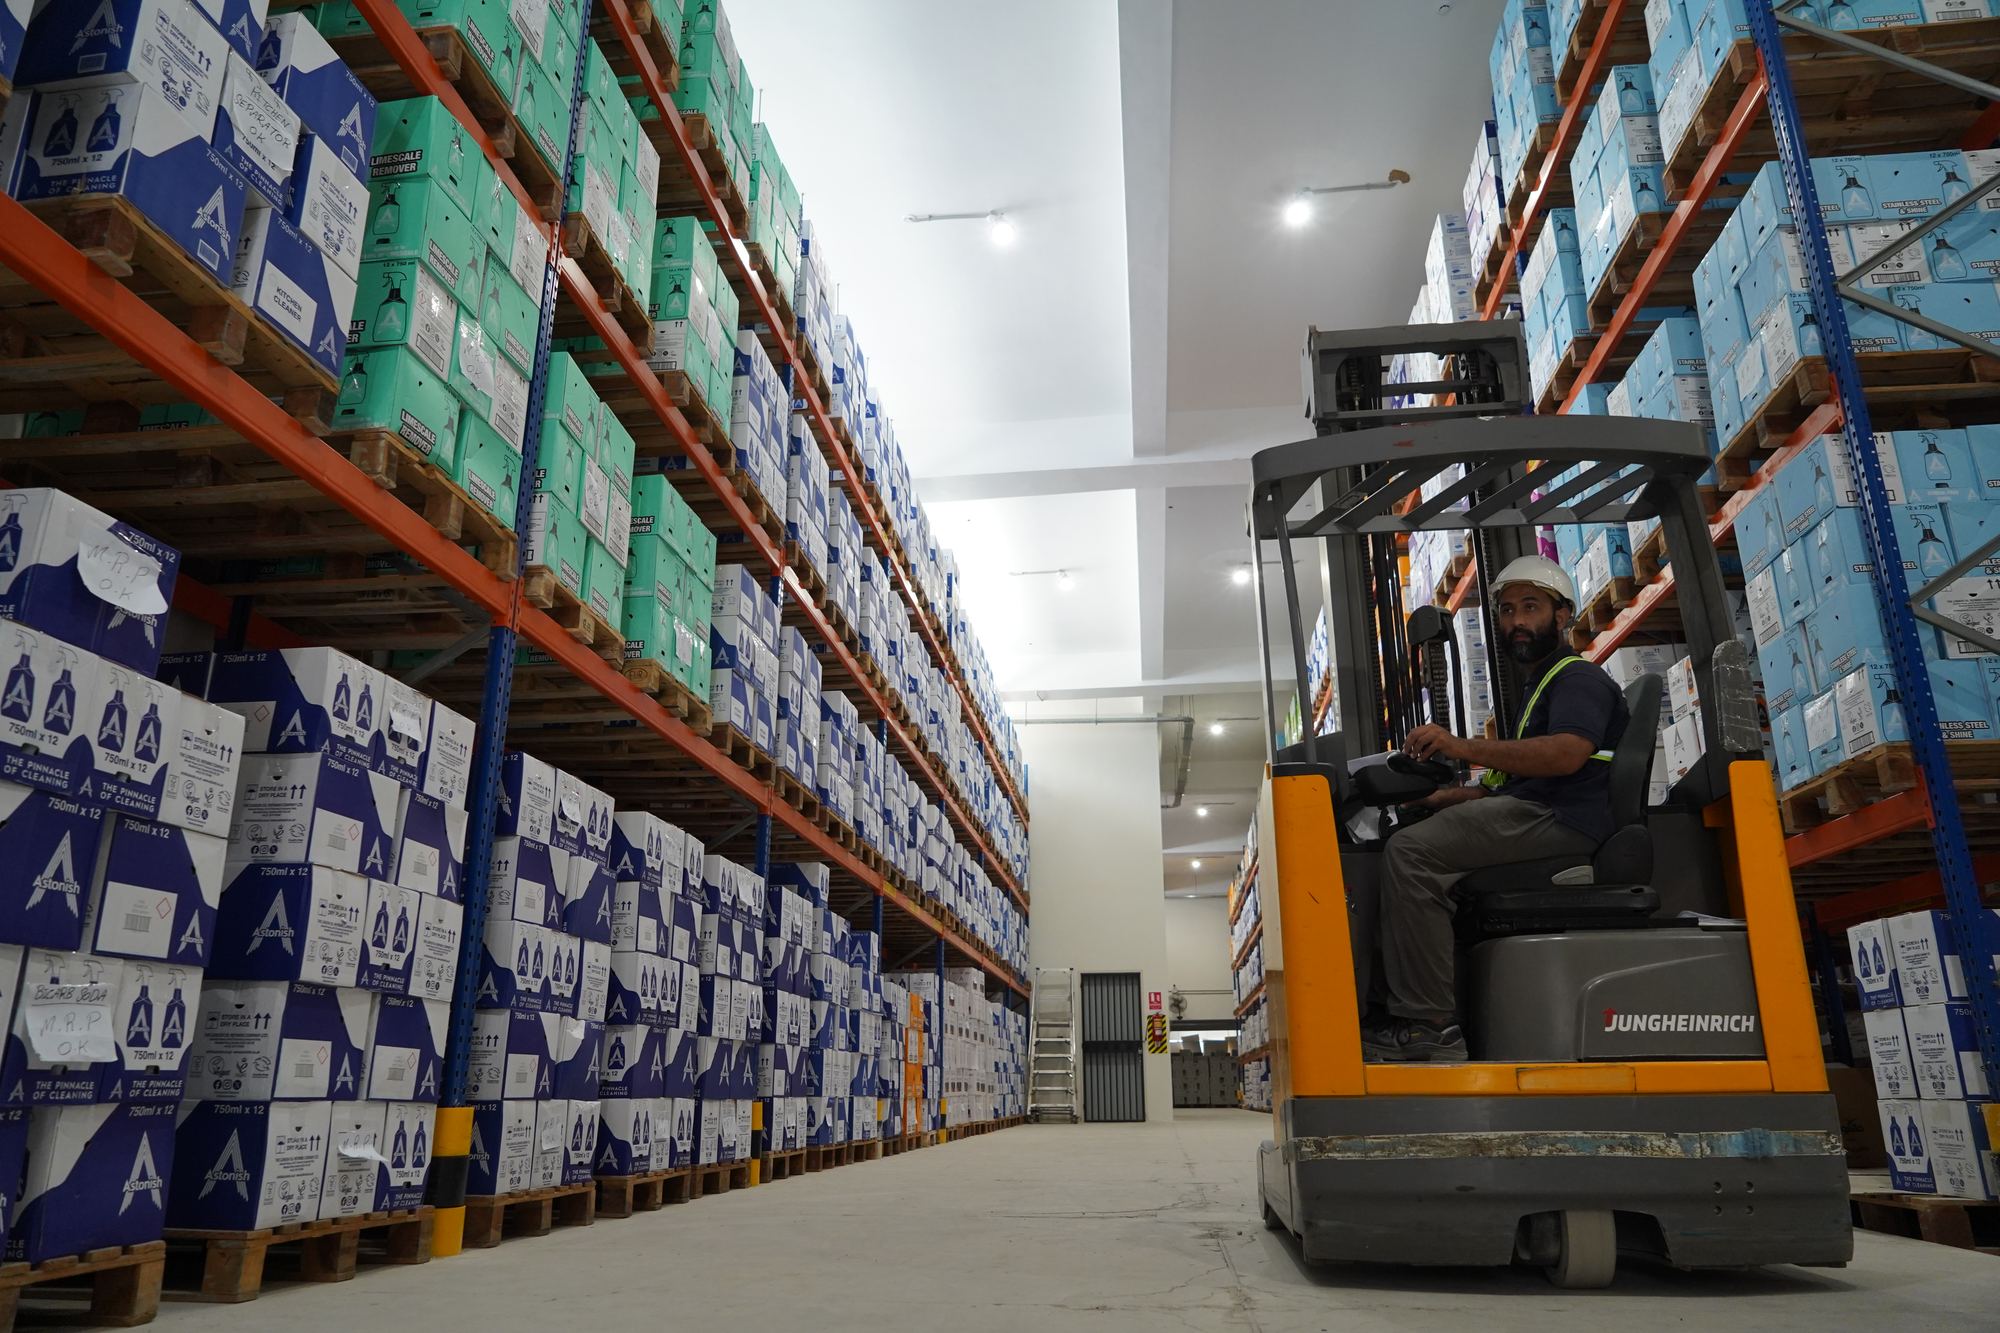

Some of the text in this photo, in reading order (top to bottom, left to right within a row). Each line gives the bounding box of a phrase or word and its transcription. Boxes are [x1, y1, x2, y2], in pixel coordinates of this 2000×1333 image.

[76, 25, 123, 39] Astonish
[250, 86, 290, 128] KITCHEN
[234, 93, 292, 149] SEPARATOR
[249, 125, 265, 144] OK
[91, 153, 103, 162] 12
[371, 150, 422, 166] LIMESCALE
[206, 149, 228, 175] 750ml
[235, 179, 244, 191] 12
[241, 155, 283, 199] THE PINNACLE
[372, 162, 417, 177] REMOVER
[240, 162, 282, 206] OF CLEANING
[1882, 198, 1942, 209] STAINLESS STEEL
[197, 207, 231, 242] Astonish
[277, 217, 298, 241] 750ml
[304, 243, 313, 253] 12
[429, 239, 460, 279] LIMESCALE
[429, 252, 456, 288] REMOVER
[273, 295, 302, 322] CLEANER
[276, 286, 302, 313] KITCHEN
[401, 409, 436, 444] LIMESCALE
[400, 424, 432, 455] REMOVER
[469, 469, 495, 498] LIMESCALE
[469, 482, 493, 510] REMOVER
[129, 531, 156, 552] 750ml
[163, 550, 176, 563] 12
[223, 654, 247, 663] 750ml
[256, 653, 267, 662] 12
[9, 722, 59, 746] 750ml x 12
[336, 744, 371, 762] THE PINNACLE
[345, 754, 370, 769] CLEANING
[6, 755, 70, 780] THE PINNACLE
[104, 752, 148, 774] 750ml x 12
[327, 758, 346, 773] 750ml
[351, 767, 360, 777] 12
[4, 765, 69, 790] OF CLEANING
[100, 791, 155, 813] OF CLEANING
[102, 782, 156, 805] THE PINNACLE
[48, 797, 101, 820] 750ml x 12
[124, 819, 170, 839] 750ml x 12
[298, 868, 308, 876] 12
[33, 875, 81, 894] Astonish
[252, 926, 294, 938] Astonish
[376, 950, 389, 959] 750ml
[34, 985, 108, 1002] BICARB SODA
[1603, 1013, 1756, 1033] JUNGHEINRICH
[134, 1051, 157, 1060] 750ml
[165, 1051, 174, 1060] 12
[36, 1081, 95, 1090] THE PINNACLE
[129, 1088, 180, 1097] OF CLEANING
[132, 1079, 183, 1089] THE PINNACLE
[33, 1091, 93, 1100] OF CLEANING
[8, 1110, 23, 1120] 12
[129, 1105, 175, 1117] 750ml x 12
[214, 1105, 242, 1114] 750ml
[253, 1105, 264, 1114] 12
[122, 1176, 163, 1192] Astonish
[205, 1168, 250, 1182] Astonish
